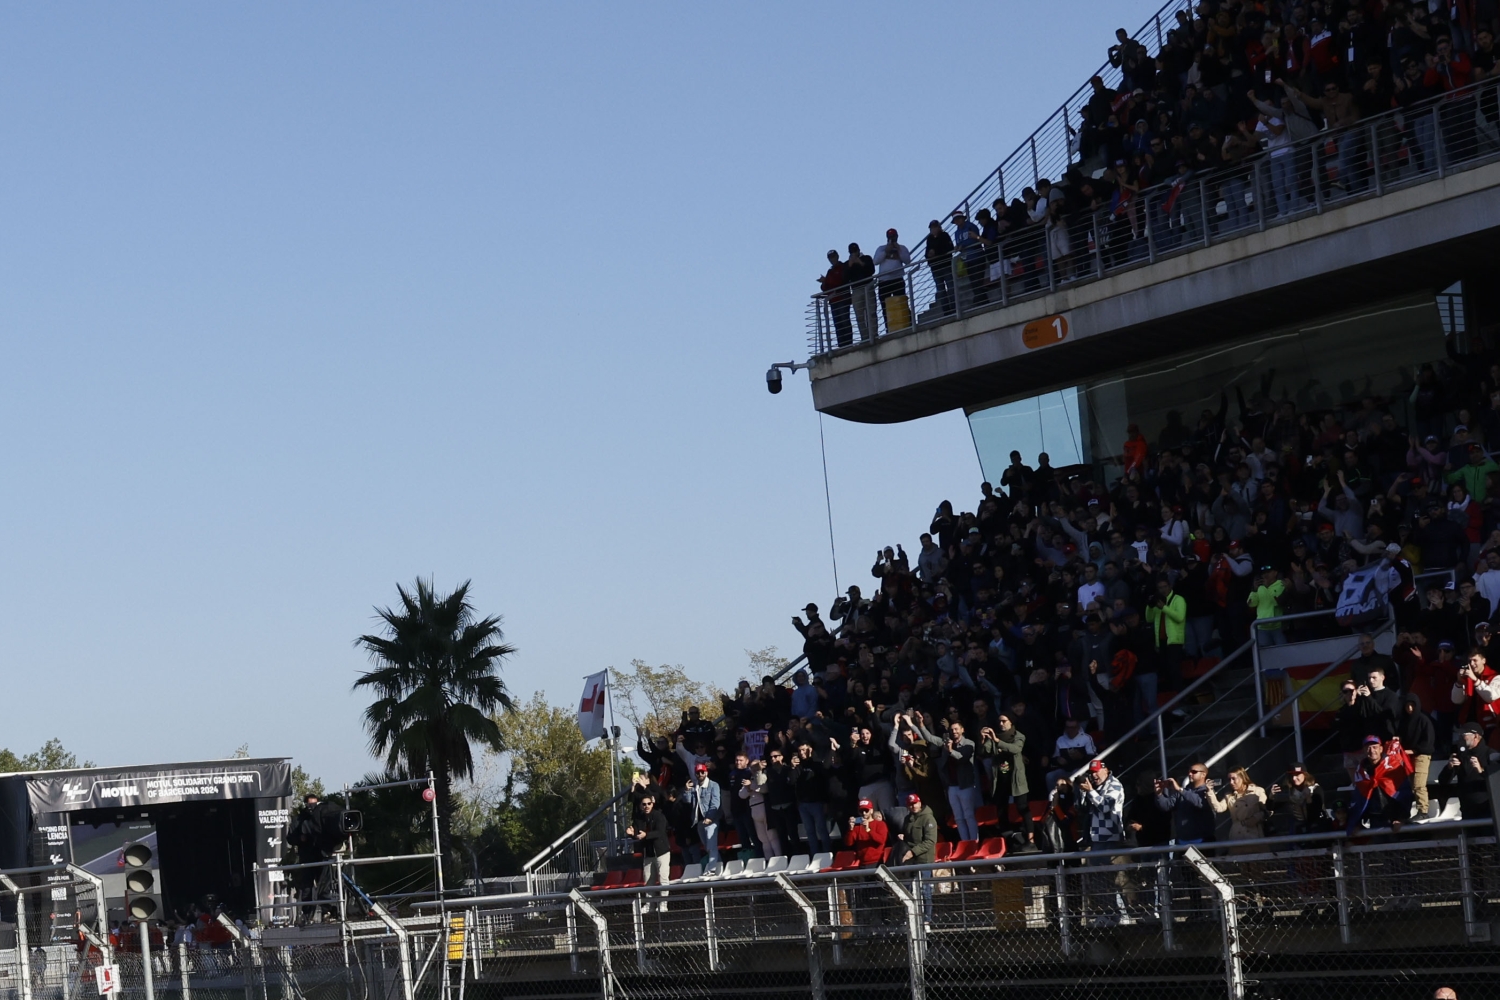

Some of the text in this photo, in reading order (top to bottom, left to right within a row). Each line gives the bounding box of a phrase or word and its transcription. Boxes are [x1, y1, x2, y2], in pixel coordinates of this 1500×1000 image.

[1052, 318, 1062, 338] 1
[173, 777, 212, 788] SOLIDARITY
[213, 775, 237, 785] GRAND
[238, 774, 254, 783] PRIX
[101, 785, 139, 798] MOTUL
[147, 785, 219, 798] OF BARCELONA 2024
[258, 815, 289, 824] VALENCIA
